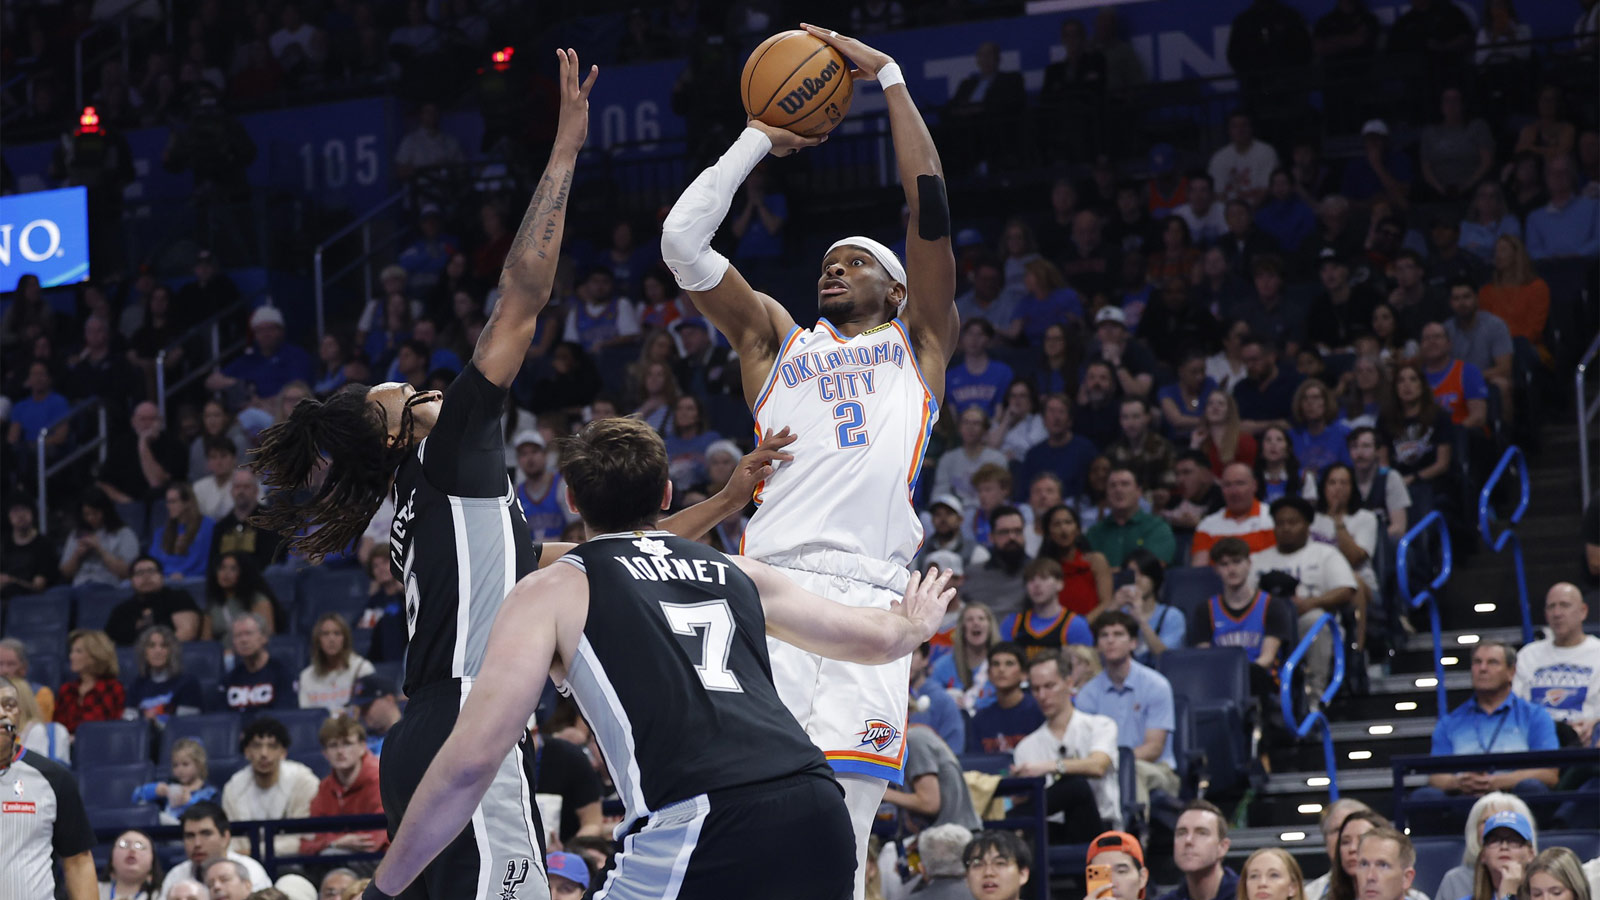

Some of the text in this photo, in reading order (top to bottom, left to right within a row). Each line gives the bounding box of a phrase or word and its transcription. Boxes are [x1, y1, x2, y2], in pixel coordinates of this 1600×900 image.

[777, 60, 840, 114] Wilson
[586, 101, 661, 158] 06
[299, 135, 379, 190] 105
[779, 341, 905, 388] OKLAHOMA
[818, 369, 875, 402] CITY
[833, 400, 869, 449] 2
[613, 556, 729, 585] KORNET
[658, 599, 744, 693] 7
[227, 683, 273, 707] OKC
[862, 727, 890, 742] OKC
